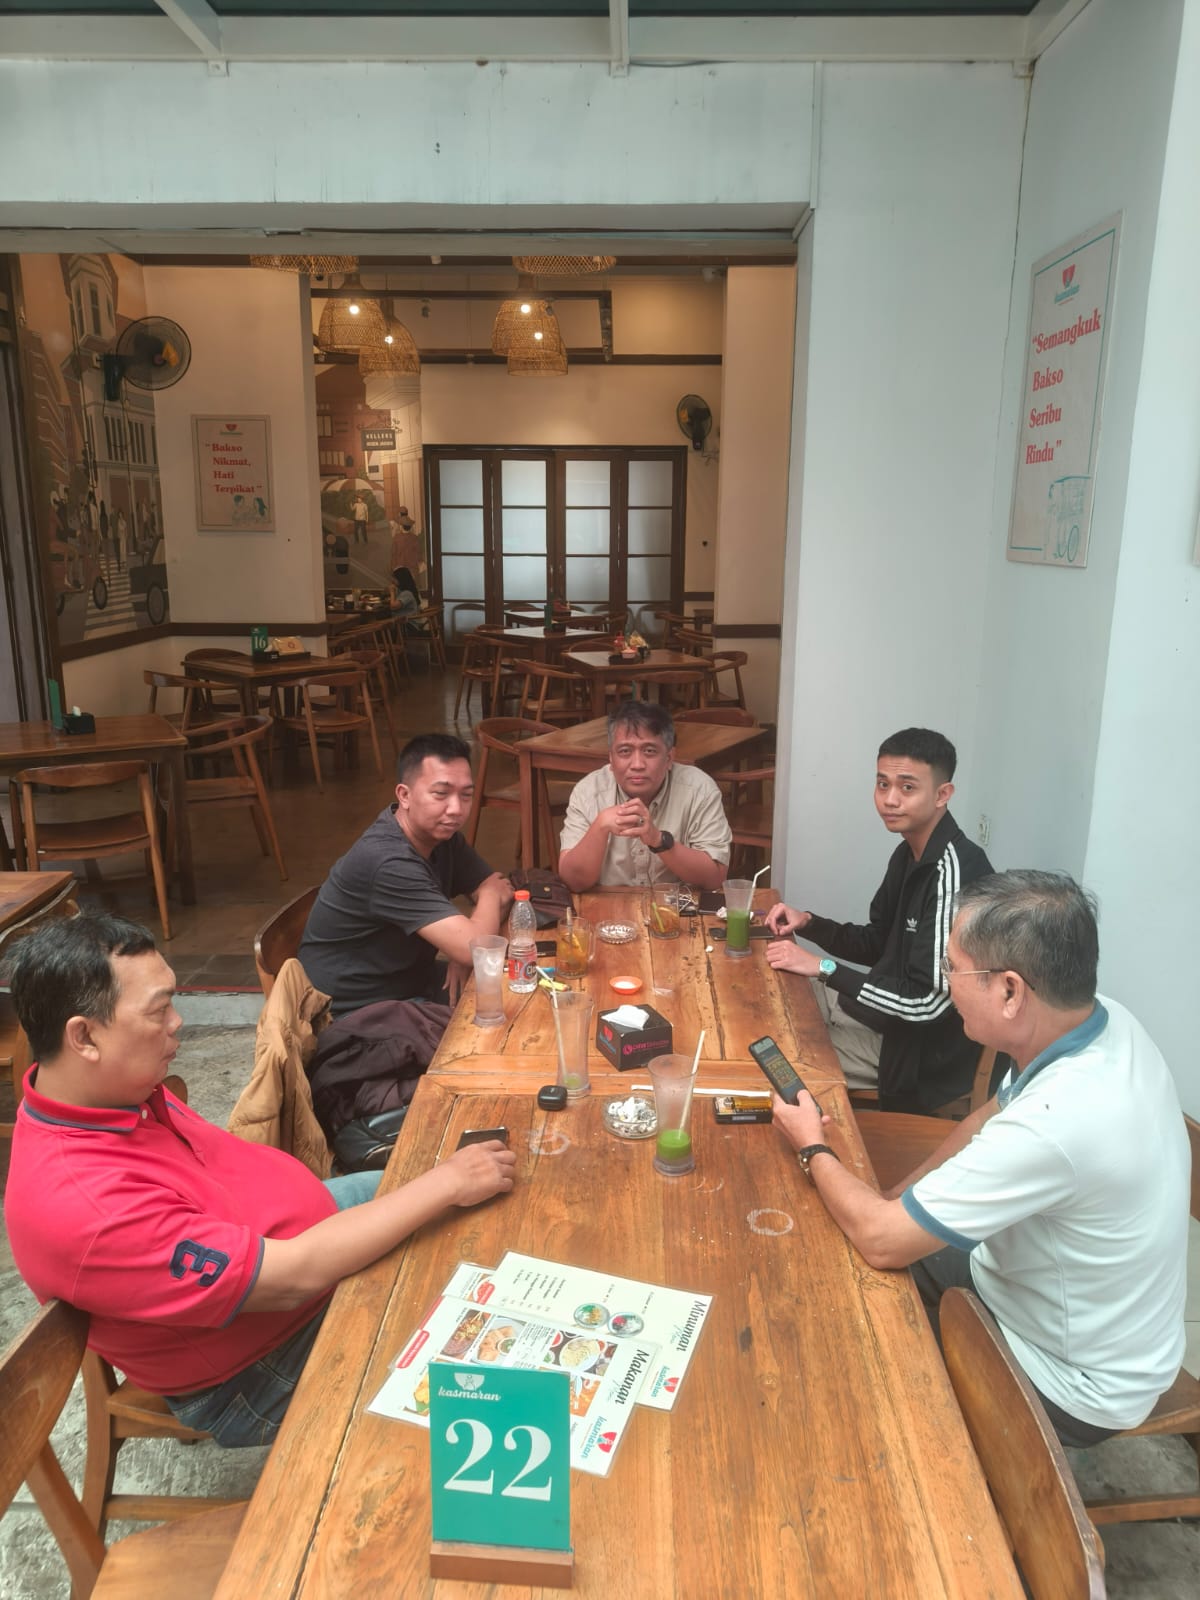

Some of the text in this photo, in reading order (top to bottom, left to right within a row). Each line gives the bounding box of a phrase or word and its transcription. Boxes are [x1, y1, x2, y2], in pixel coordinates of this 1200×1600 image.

[1032, 367, 1064, 392] Bakso
[1028, 403, 1062, 429] Seribu
[213, 471, 235, 480] Hati
[169, 1238, 230, 1287] 3
[676, 1300, 708, 1352] Minuman
[437, 1386, 502, 1402] kasmaran
[615, 1349, 650, 1405] Makanan
[443, 1418, 552, 1502] 22
